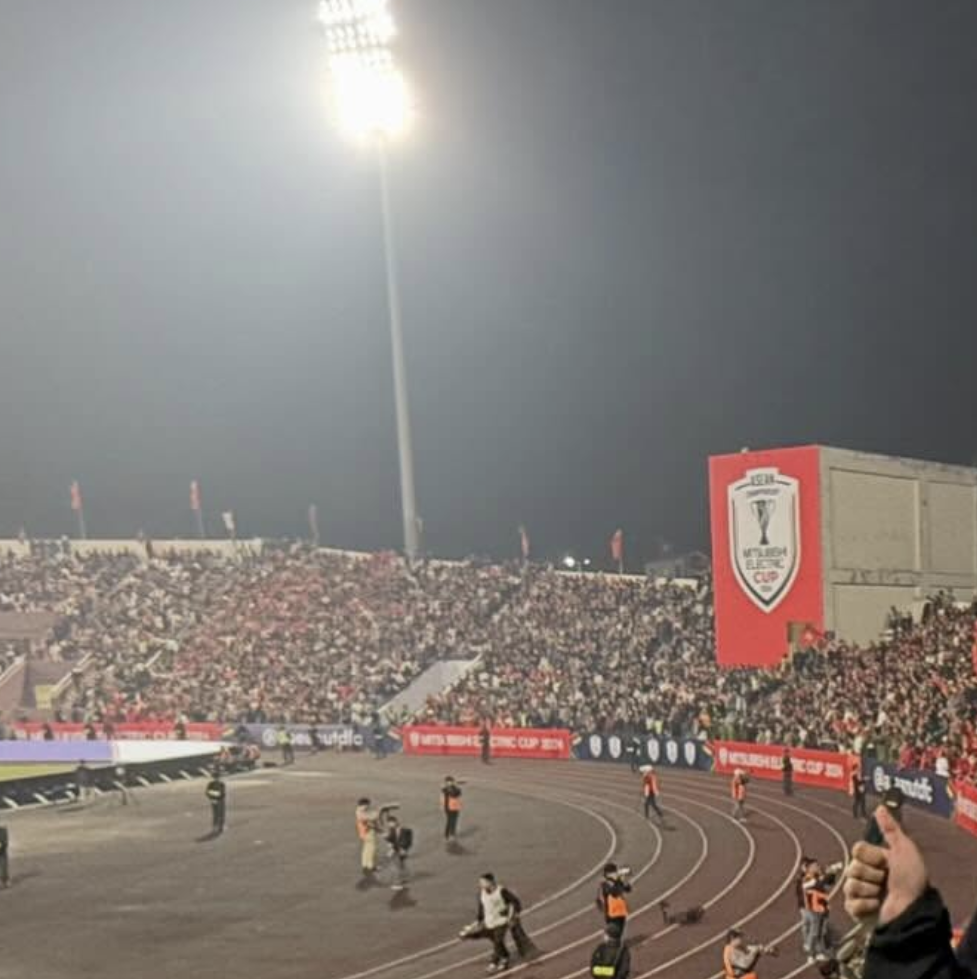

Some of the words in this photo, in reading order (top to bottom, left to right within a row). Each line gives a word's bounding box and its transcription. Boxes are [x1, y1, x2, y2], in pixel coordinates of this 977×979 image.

[743, 546, 788, 559] MITSUBISHI
[745, 558, 785, 571] ELECTRIC
[753, 570, 780, 584] CUP
